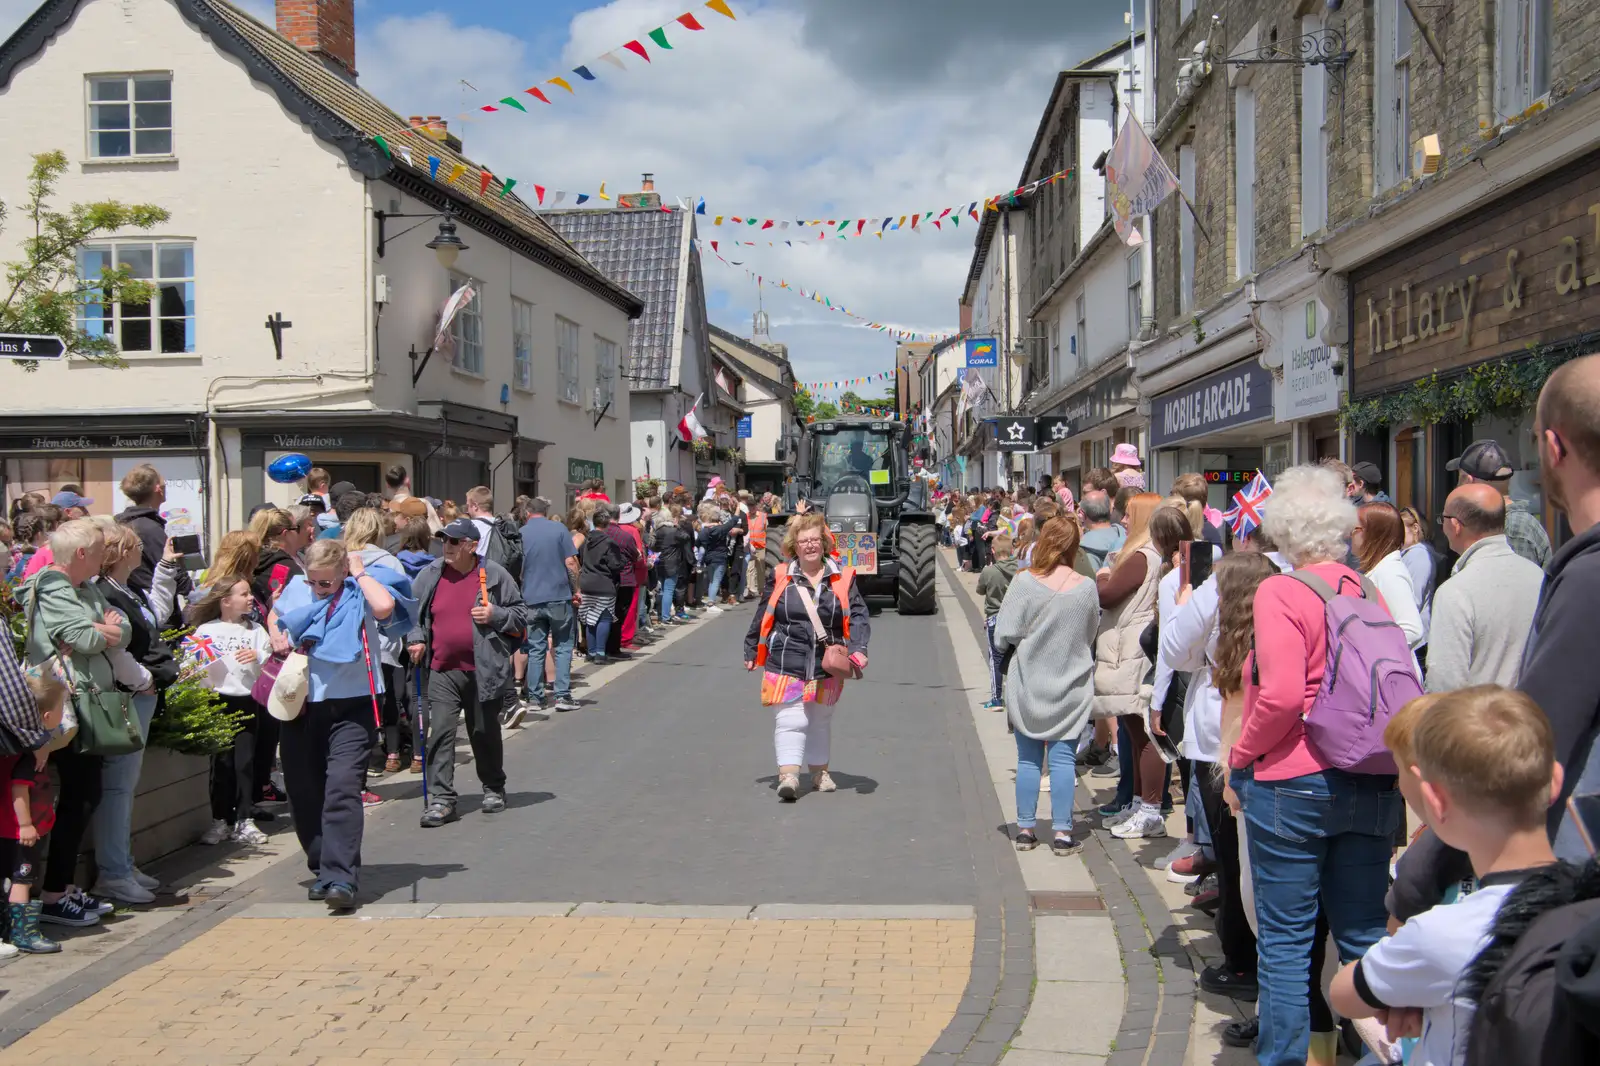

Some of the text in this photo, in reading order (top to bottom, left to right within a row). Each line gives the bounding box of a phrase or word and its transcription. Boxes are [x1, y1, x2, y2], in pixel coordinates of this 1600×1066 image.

[1367, 275, 1478, 356] hilary
[1503, 248, 1523, 312] &
[1292, 344, 1331, 371] Halesgroup
[1164, 372, 1251, 435] MOBILE ARCADE
[110, 434, 163, 448] Jewellers
[273, 434, 343, 447] Valuations
[1204, 471, 1241, 481] MOBILE
